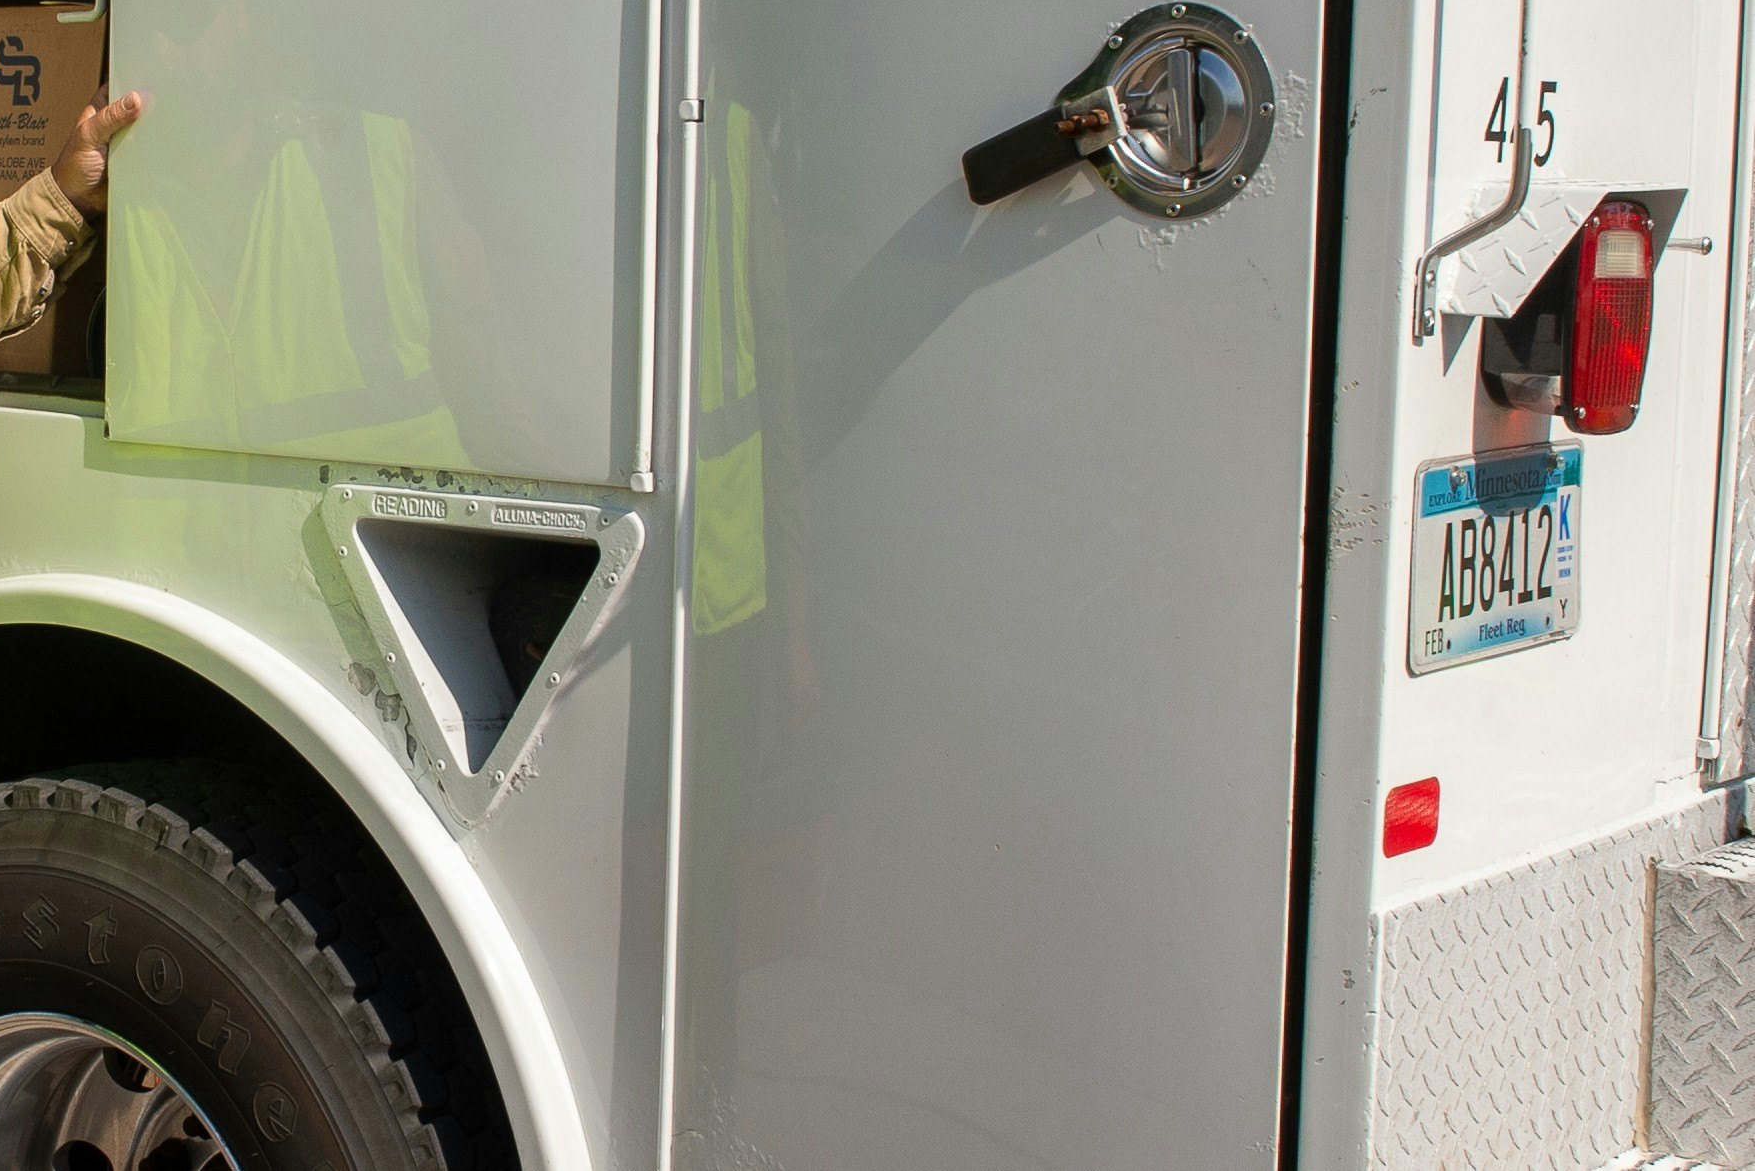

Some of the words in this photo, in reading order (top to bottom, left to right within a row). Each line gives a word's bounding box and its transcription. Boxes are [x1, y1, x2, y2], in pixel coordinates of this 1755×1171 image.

[1484, 76, 1557, 168] 45
[22, 134, 46, 146] brand
[27, 157, 46, 169] AVE
[375, 494, 446, 518] READING
[1428, 489, 1462, 508] EXPLORE
[1559, 493, 1571, 541] K
[1438, 504, 1553, 623] AB8412
[1425, 627, 1443, 657] FEB
[1478, 621, 1505, 642] Fleet
[1506, 618, 1525, 636] Reg
